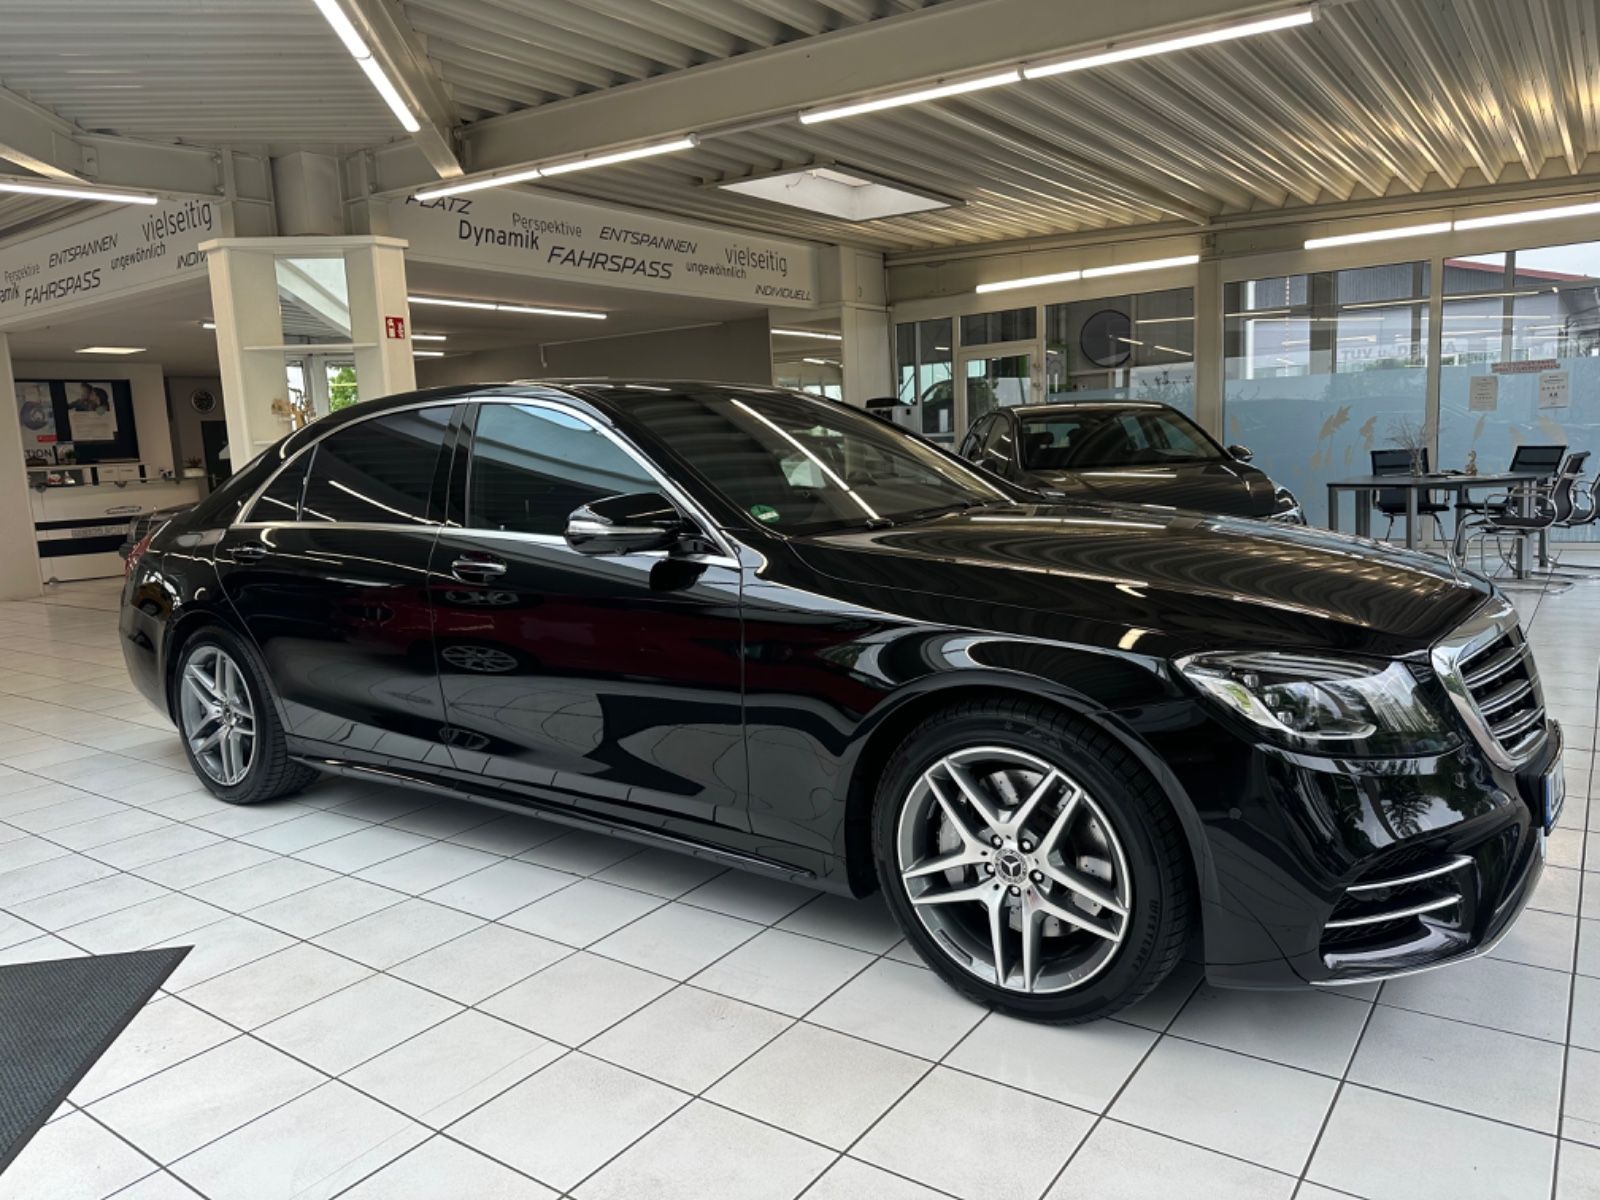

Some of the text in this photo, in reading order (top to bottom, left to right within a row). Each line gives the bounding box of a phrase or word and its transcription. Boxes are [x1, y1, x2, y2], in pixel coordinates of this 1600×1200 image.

[142, 199, 212, 242] vielseitig
[458, 219, 540, 250] Dynamik
[512, 212, 582, 238] Perspektive
[48, 233, 118, 268] ENTSPANNEN
[600, 226, 698, 255] ENTSPANNEN
[110, 241, 166, 271] ungewöhnlich
[176, 251, 208, 270] INDIV
[547, 245, 673, 280] FAHRSPASS
[686, 262, 747, 279] ungewöhnlich
[725, 244, 788, 278] vielseitig
[4, 263, 41, 284] Perspektive
[24, 268, 102, 307] FAHRSPASS
[755, 284, 812, 301] INDIVIDUELL
